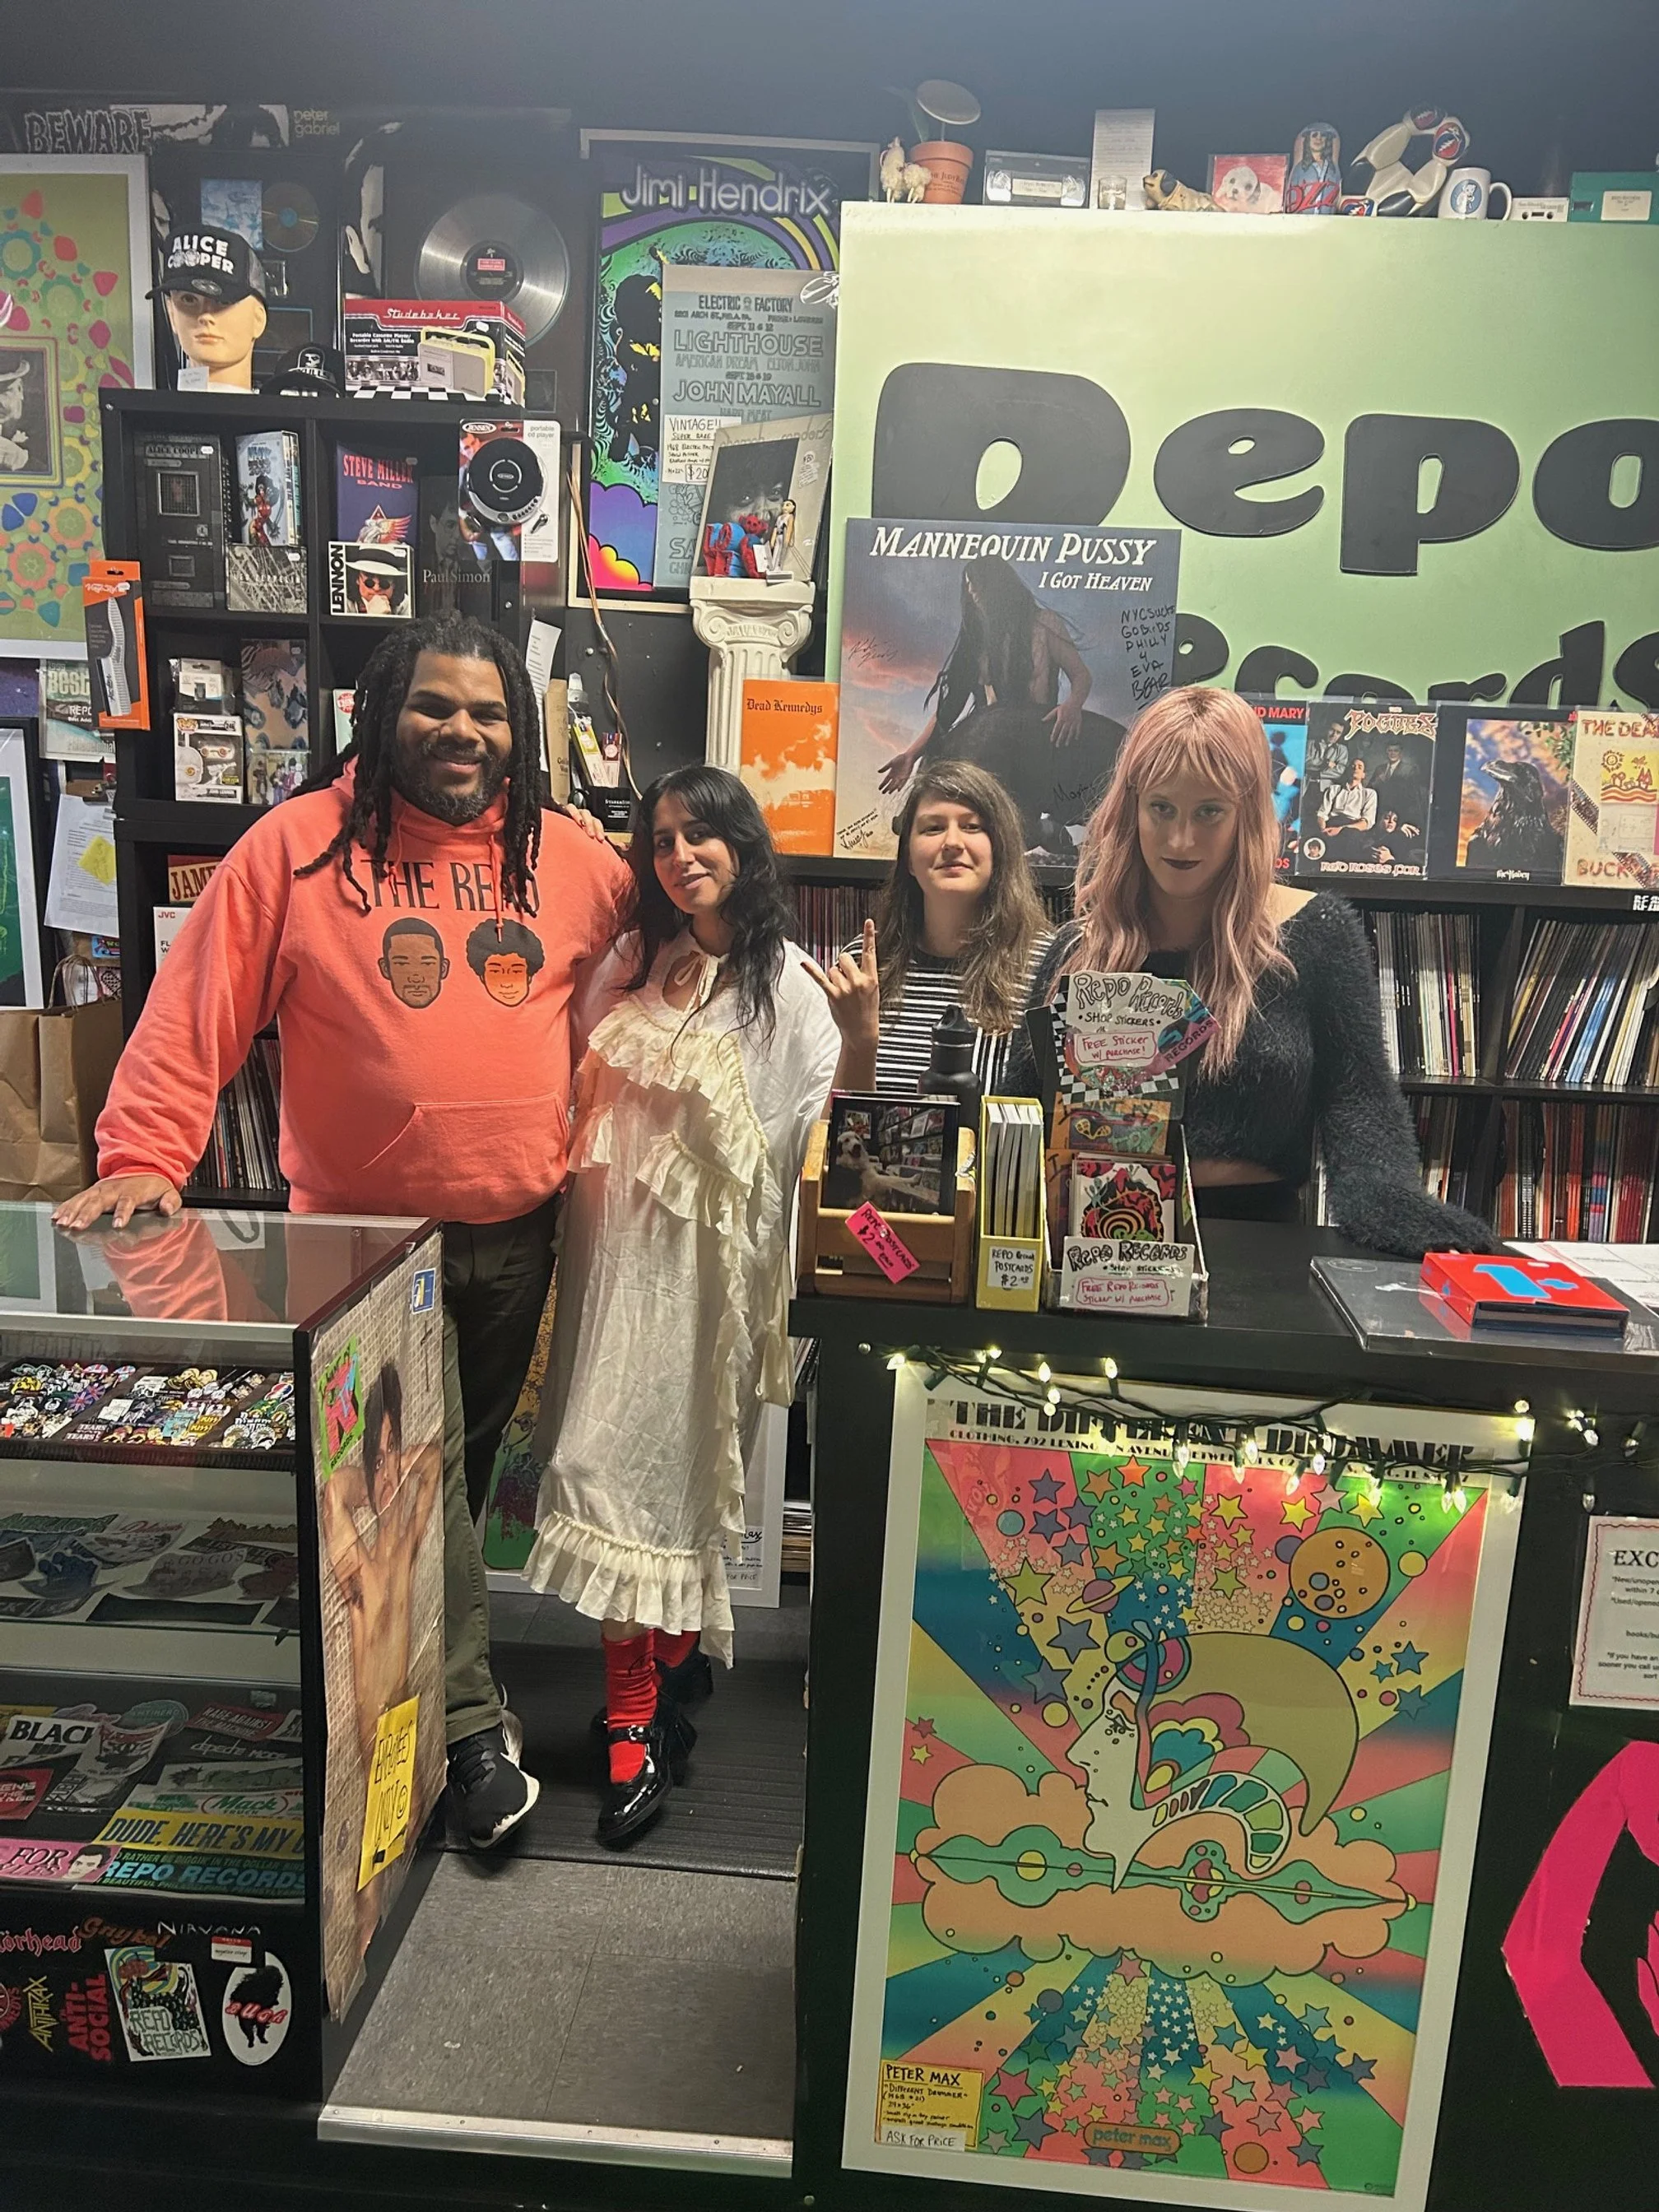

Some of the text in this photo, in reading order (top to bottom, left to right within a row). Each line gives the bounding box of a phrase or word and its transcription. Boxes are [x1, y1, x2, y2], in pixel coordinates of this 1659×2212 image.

[294, 108, 328, 123] peter
[25, 108, 152, 154] BEWARE
[295, 121, 340, 136] gabriel
[621, 164, 830, 216] Jimi Hendrix
[173, 235, 229, 258] ALICE
[167, 251, 235, 276] COOPER
[699, 295, 793, 314] ELECTRIC FACTORY
[383, 309, 461, 320] Studebaker
[674, 329, 823, 357] LIGHTHOUSE
[673, 379, 822, 407] JOHN MAYALL
[467, 423, 493, 431] JENSEN
[343, 454, 374, 478] STEVE
[356, 479, 402, 489] BAND
[869, 526, 1157, 566] MANNEQUIN PUSSY
[330, 544, 345, 613] LENNON
[423, 569, 491, 583] Paul Simon
[1039, 572, 1153, 592] I GOT HEAVEN
[1131, 660, 1164, 678] EVA
[1132, 672, 1169, 701] BEAR
[746, 699, 823, 716] Dead Kennedys
[1268, 707, 1304, 719] MARY
[1345, 709, 1438, 741] POGUES
[1582, 719, 1615, 737] THE
[1321, 862, 1420, 876] RED ROSES FOR
[360, 859, 540, 912] THE RE
[1085, 1012, 1112, 1023] SHOP
[1082, 1039, 1108, 1051] FREE
[1164, 1019, 1215, 1062] RECORDS
[992, 1248, 1014, 1260] REPO
[995, 1261, 1034, 1274] POSTCARDS
[1081, 1280, 1104, 1293] FREE
[950, 1399, 1027, 1430] THE
[203, 1707, 230, 1721] RAGE
[231, 1712, 272, 1730] AGAINST
[190, 1735, 289, 1760] depeche MODE
[210, 1796, 278, 1810] Mack
[100, 1817, 298, 1852] DUDE, HERE'S MY
[8, 1847, 70, 1866] FOR
[123, 1852, 159, 1862] RATHER
[104, 1878, 156, 1888] BEAUTIFUL
[105, 1861, 304, 1890] REPO RECORDS
[157, 1921, 261, 1936] NIRVANA
[22, 1975, 59, 2052] ANTHRAX
[86, 1973, 112, 2061] SOCIAL
[886, 2064, 961, 2086] PETER MAX
[886, 2131, 906, 2145] ASK
[1094, 2127, 1171, 2150] peter max
